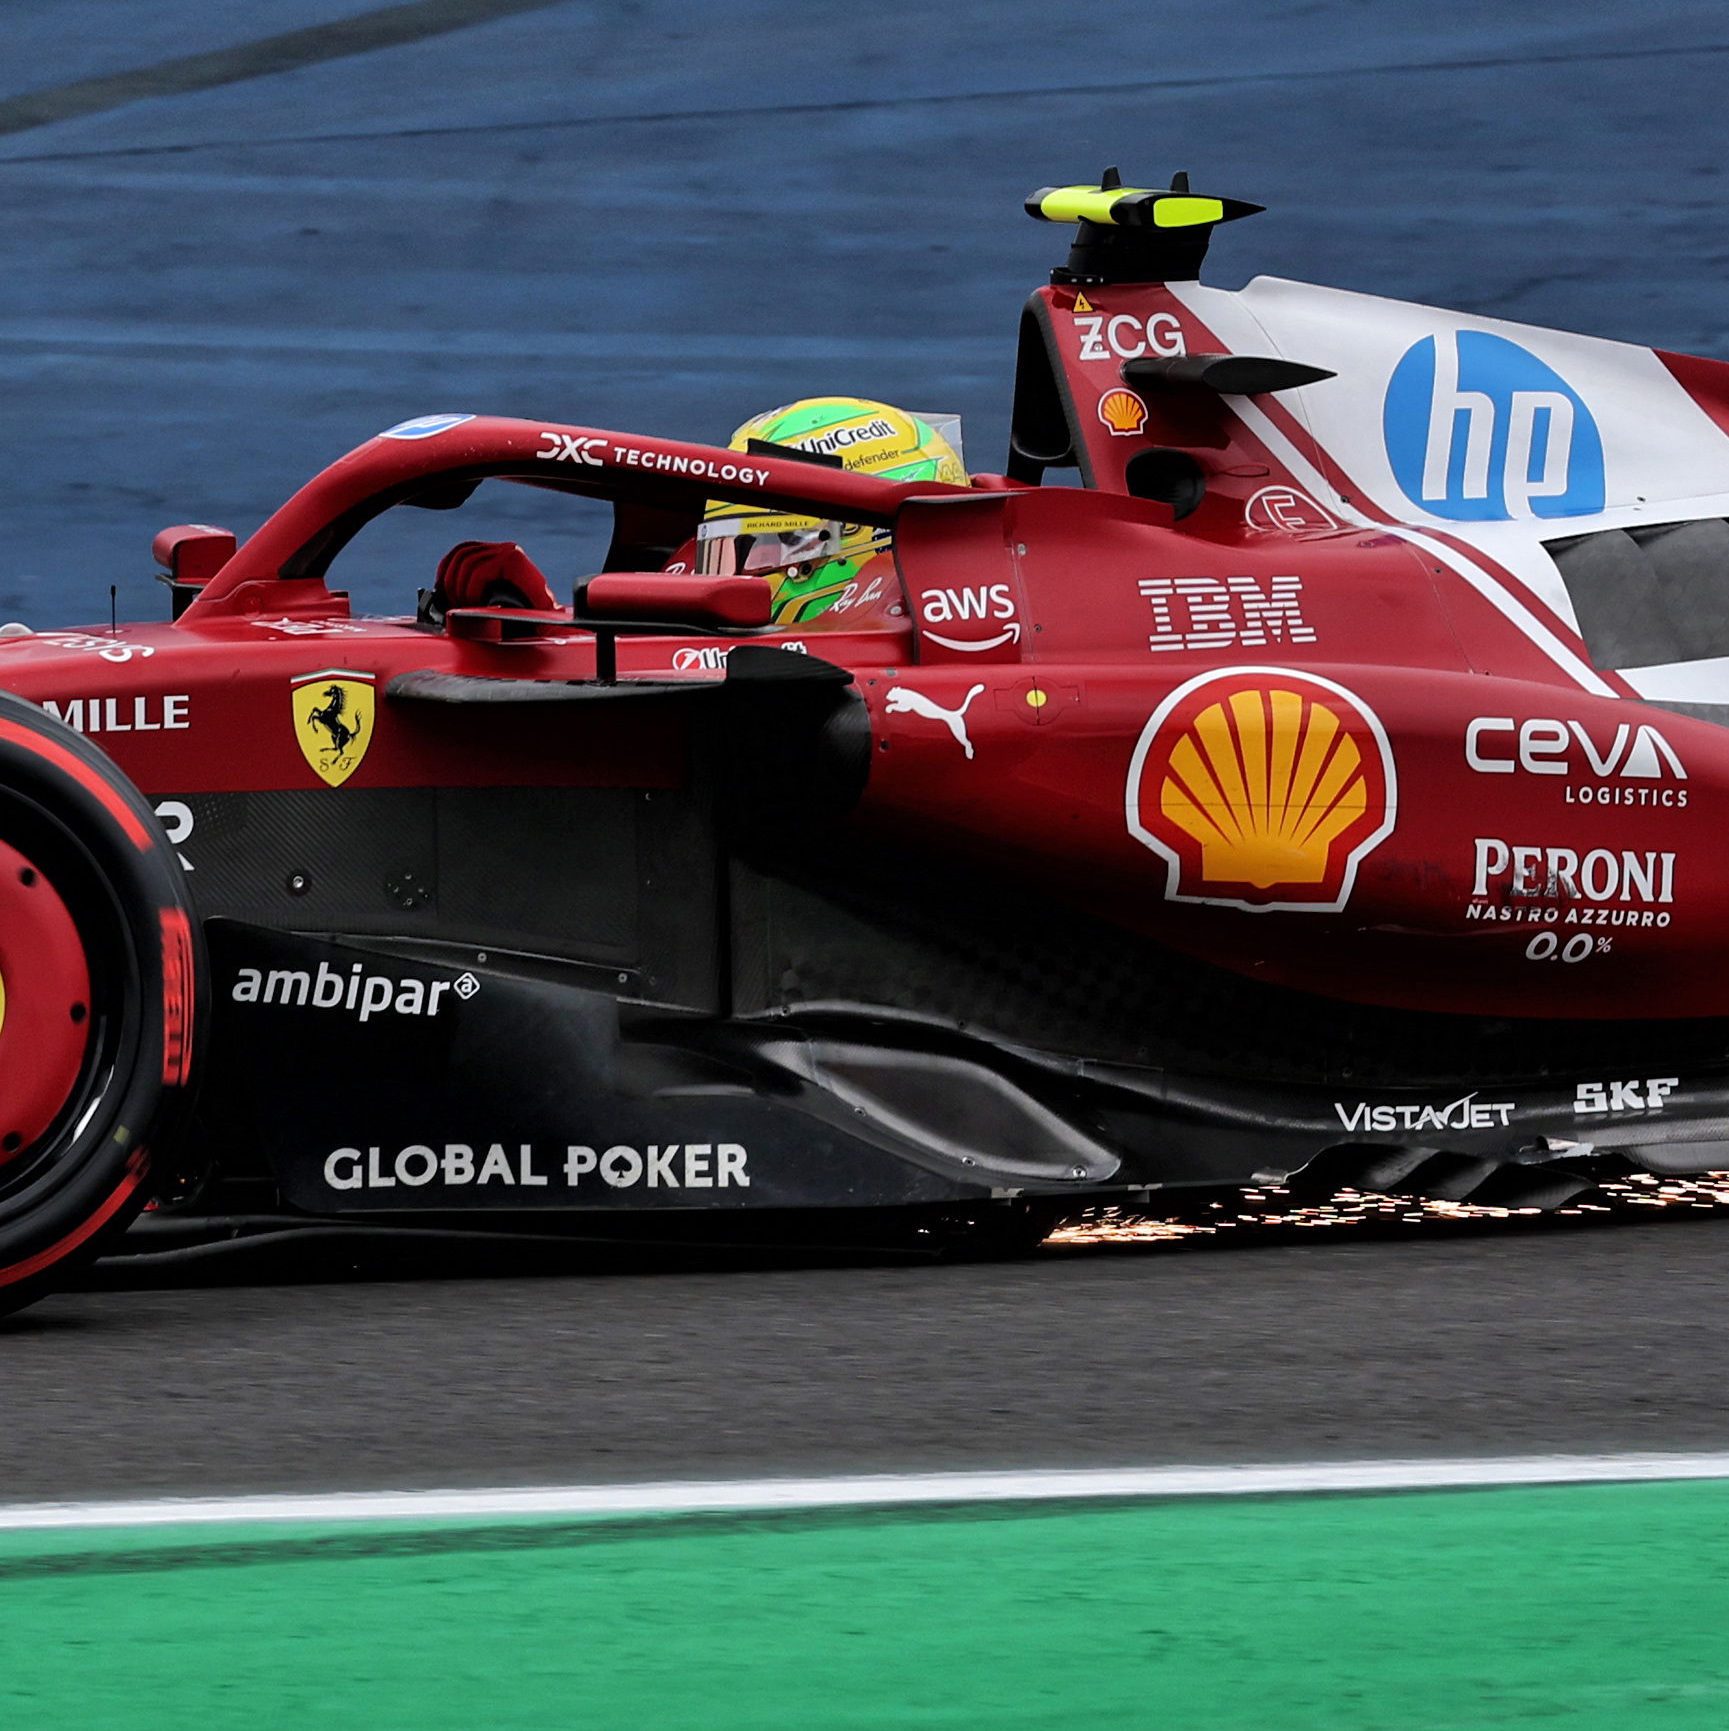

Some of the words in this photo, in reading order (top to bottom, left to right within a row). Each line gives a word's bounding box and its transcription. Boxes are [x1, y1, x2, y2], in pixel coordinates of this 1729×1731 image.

[799, 419, 897, 456] UniCredit
[1421, 329, 1575, 521] hp
[535, 431, 609, 467] DXC
[613, 446, 770, 487] TECHNOLOGY
[843, 447, 901, 472] defender
[921, 583, 1016, 623] aws
[1137, 575, 1319, 653] IBM
[42, 694, 190, 733] MILLE
[1565, 785, 1689, 808] LOGISTICS
[1471, 837, 1677, 904] PERONI
[1465, 904, 1560, 924] NASTRO
[1564, 908, 1671, 928] AZZURRO
[1524, 931, 1614, 964] 0.0%
[231, 961, 451, 1023] ambipar
[1573, 1077, 1680, 1114] SKF
[323, 1144, 549, 1191] GLOBAL
[563, 1142, 752, 1189] POKER
